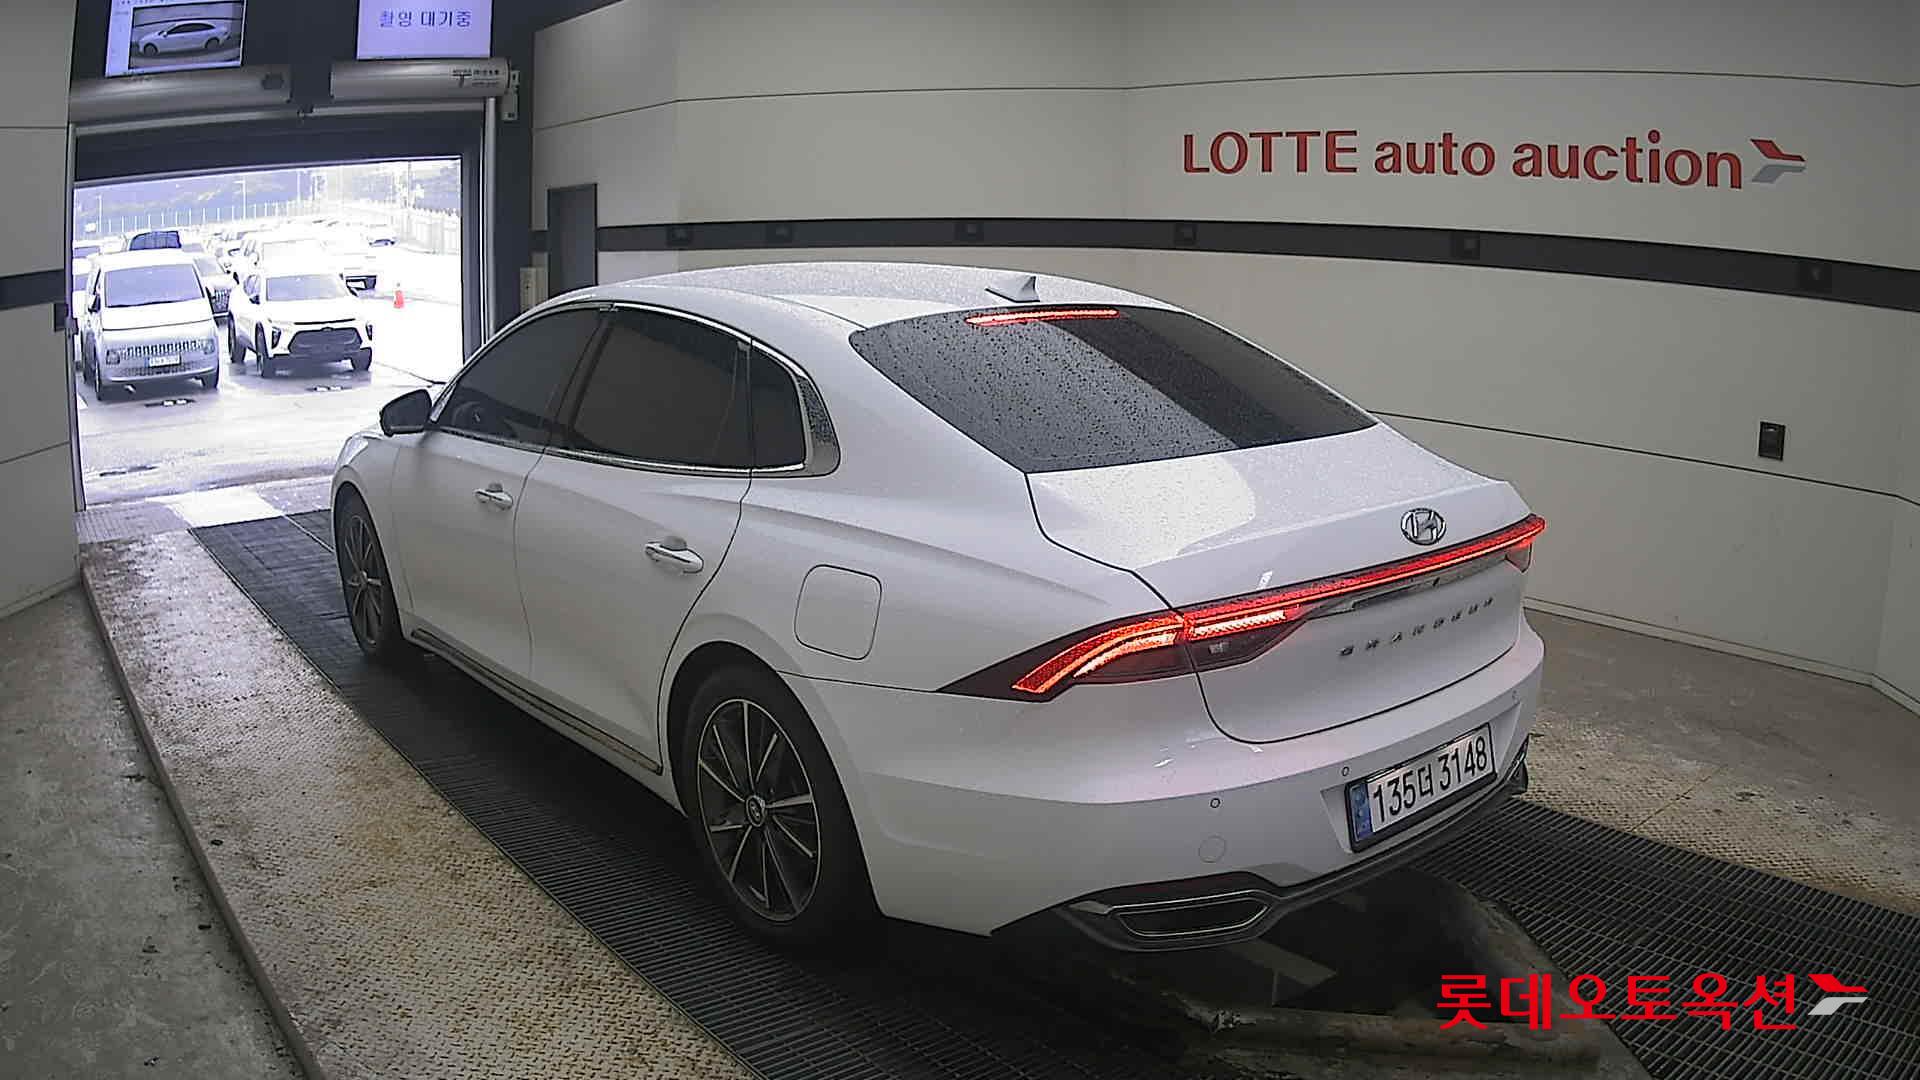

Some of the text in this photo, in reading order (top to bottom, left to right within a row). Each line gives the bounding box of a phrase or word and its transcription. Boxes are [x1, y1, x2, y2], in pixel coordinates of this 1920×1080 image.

[420, 10, 472, 27] 대기중
[1183, 129, 1743, 189] LOTTE auto auction
[1373, 735, 1488, 823] 135더 3148
